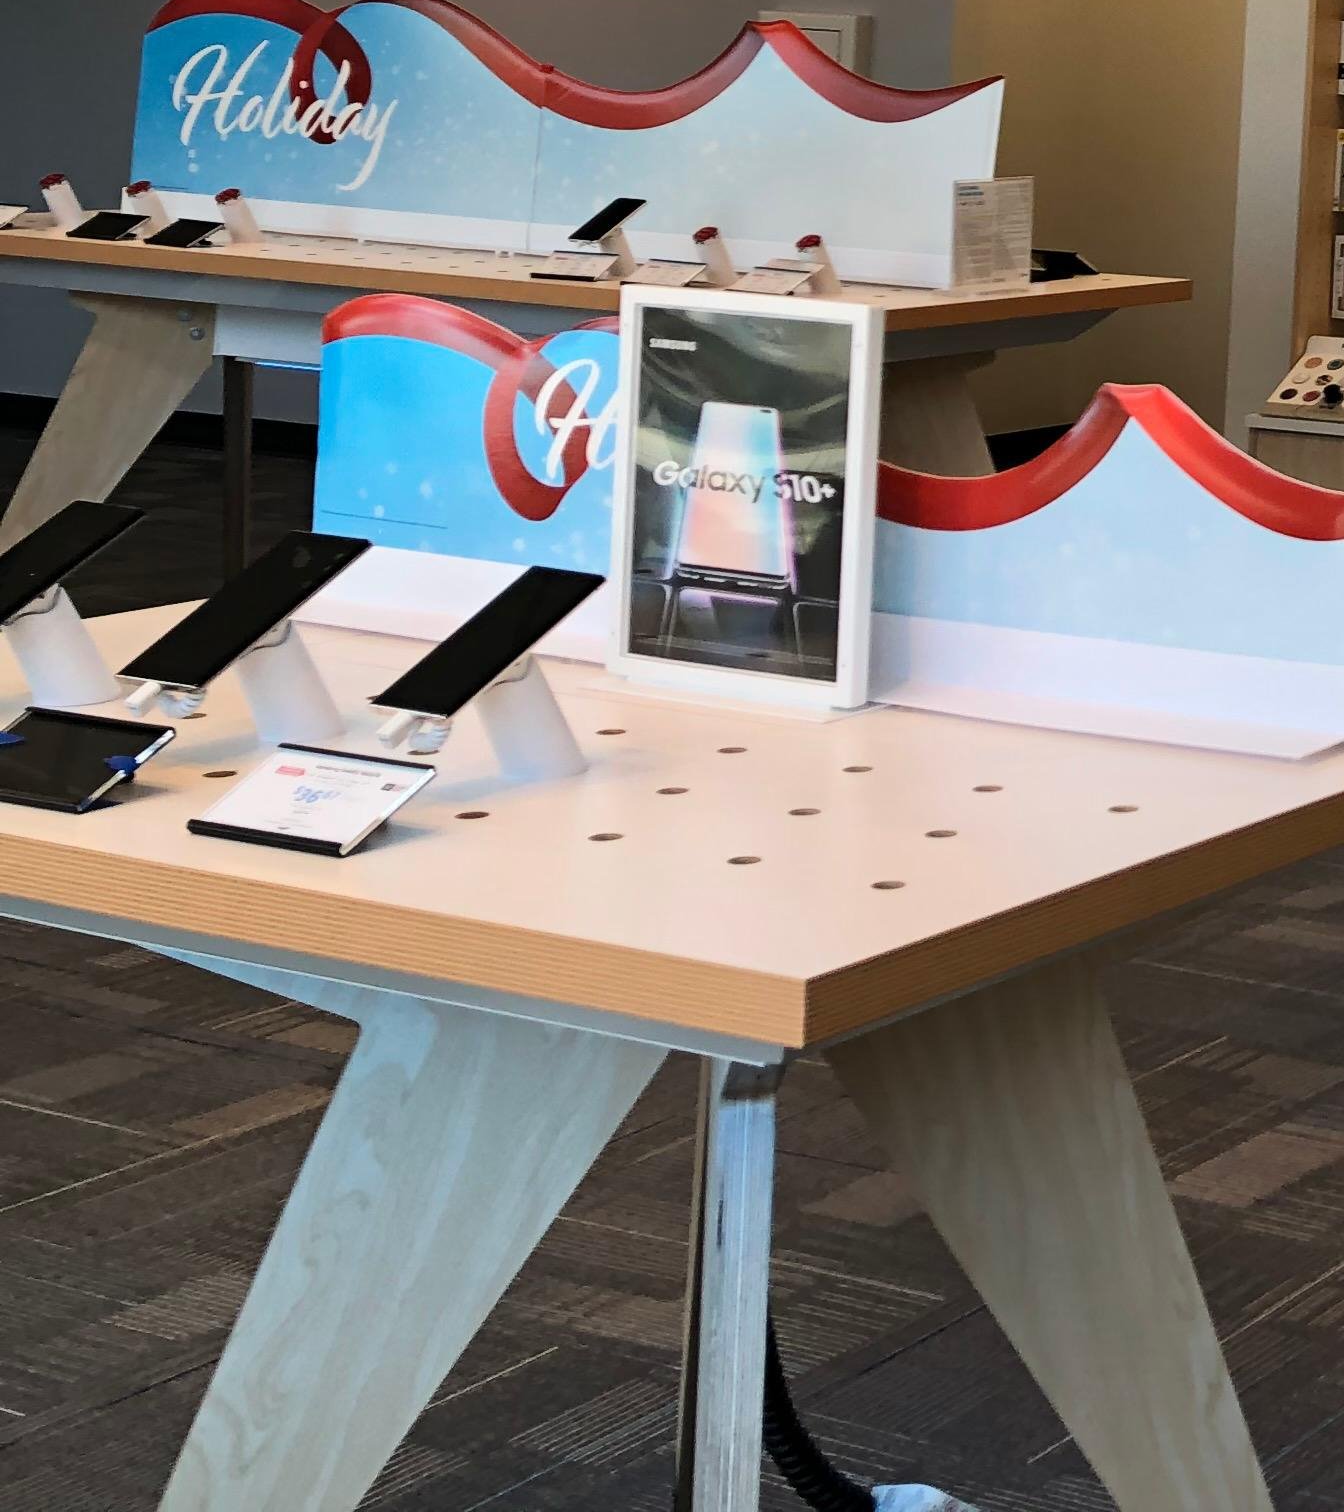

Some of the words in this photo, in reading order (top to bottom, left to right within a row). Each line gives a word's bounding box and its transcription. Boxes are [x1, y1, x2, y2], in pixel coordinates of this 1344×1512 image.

[171, 42, 400, 191] Holiday
[652, 459, 766, 504] Galaxy
[773, 471, 838, 504] S10+
